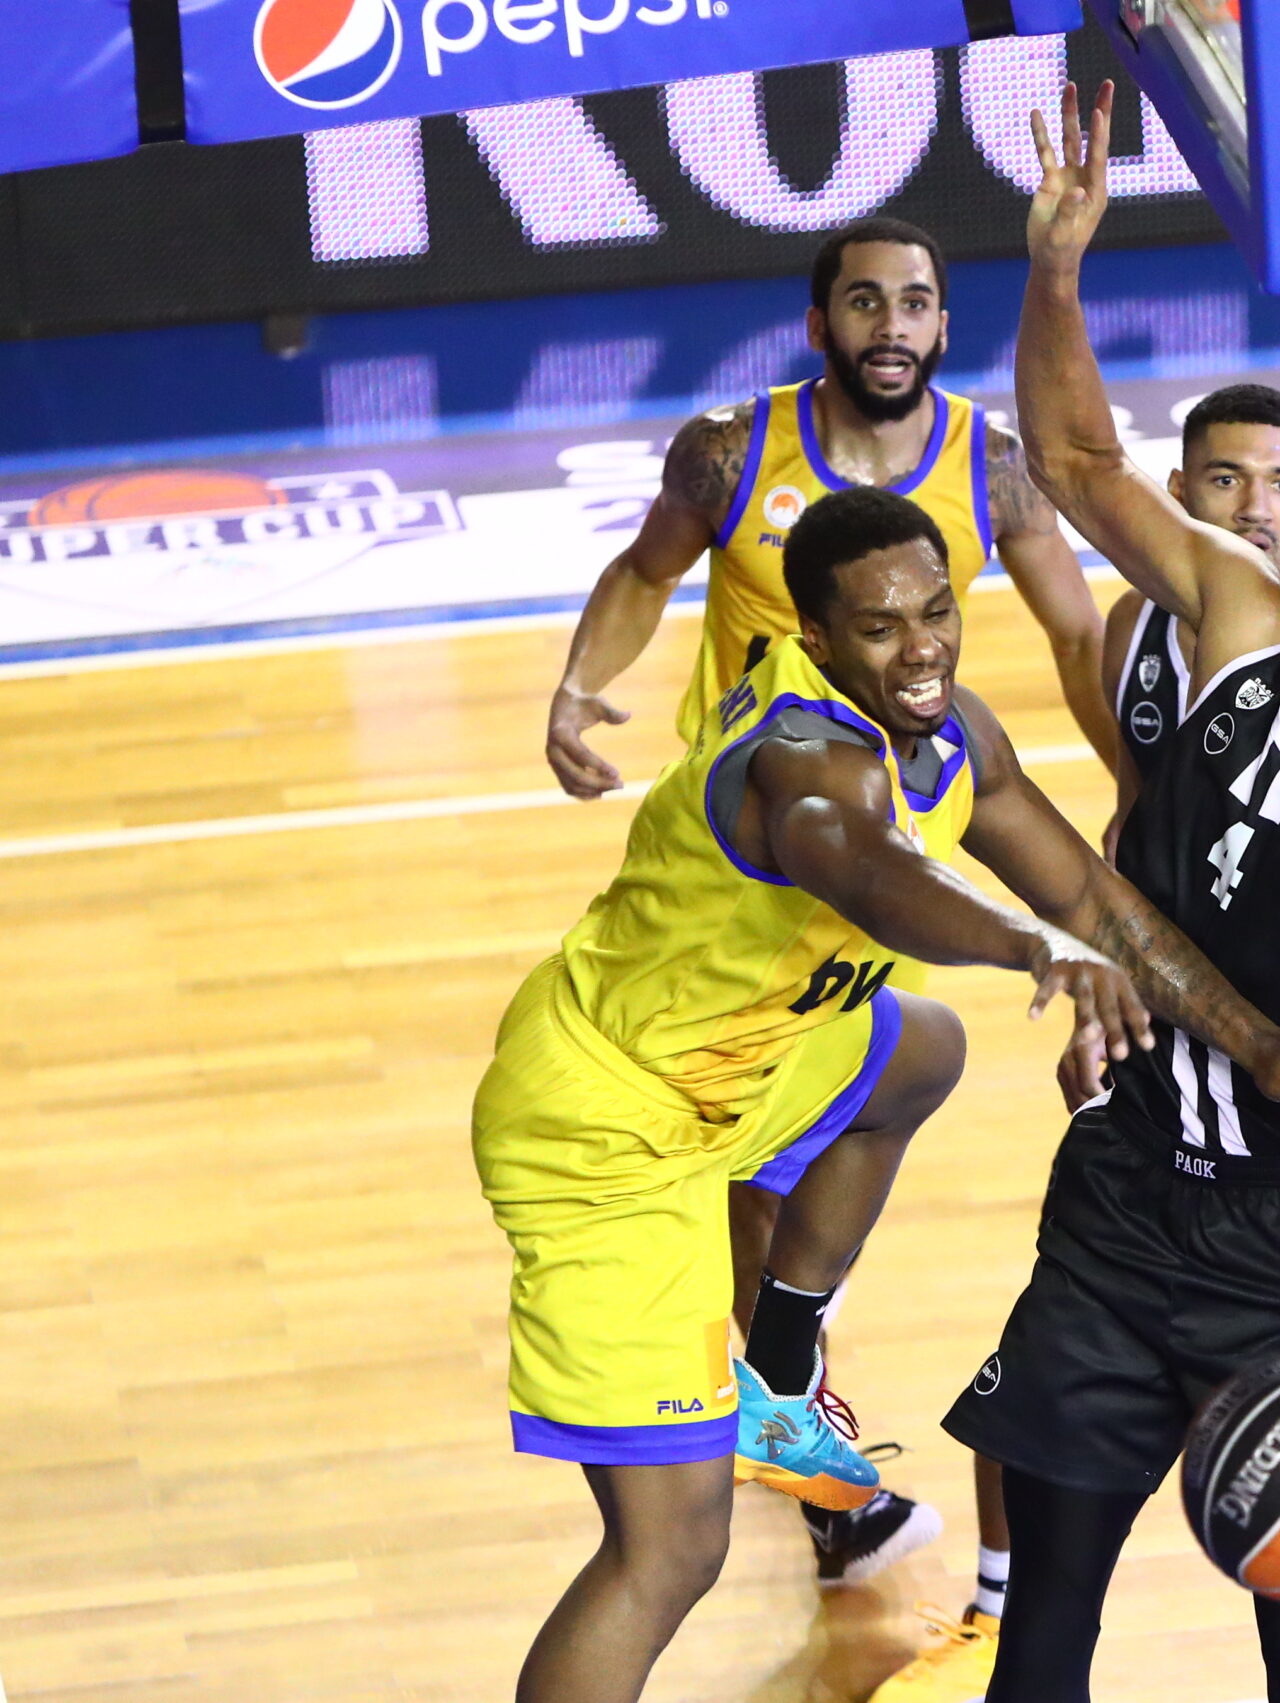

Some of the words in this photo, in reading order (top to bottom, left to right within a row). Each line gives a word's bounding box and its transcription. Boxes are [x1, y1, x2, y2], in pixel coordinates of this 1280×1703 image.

[1211, 723, 1230, 744] GSA
[1207, 821, 1255, 911] 4
[1175, 1150, 1216, 1179] PAOK
[657, 1397, 704, 1415] FILA
